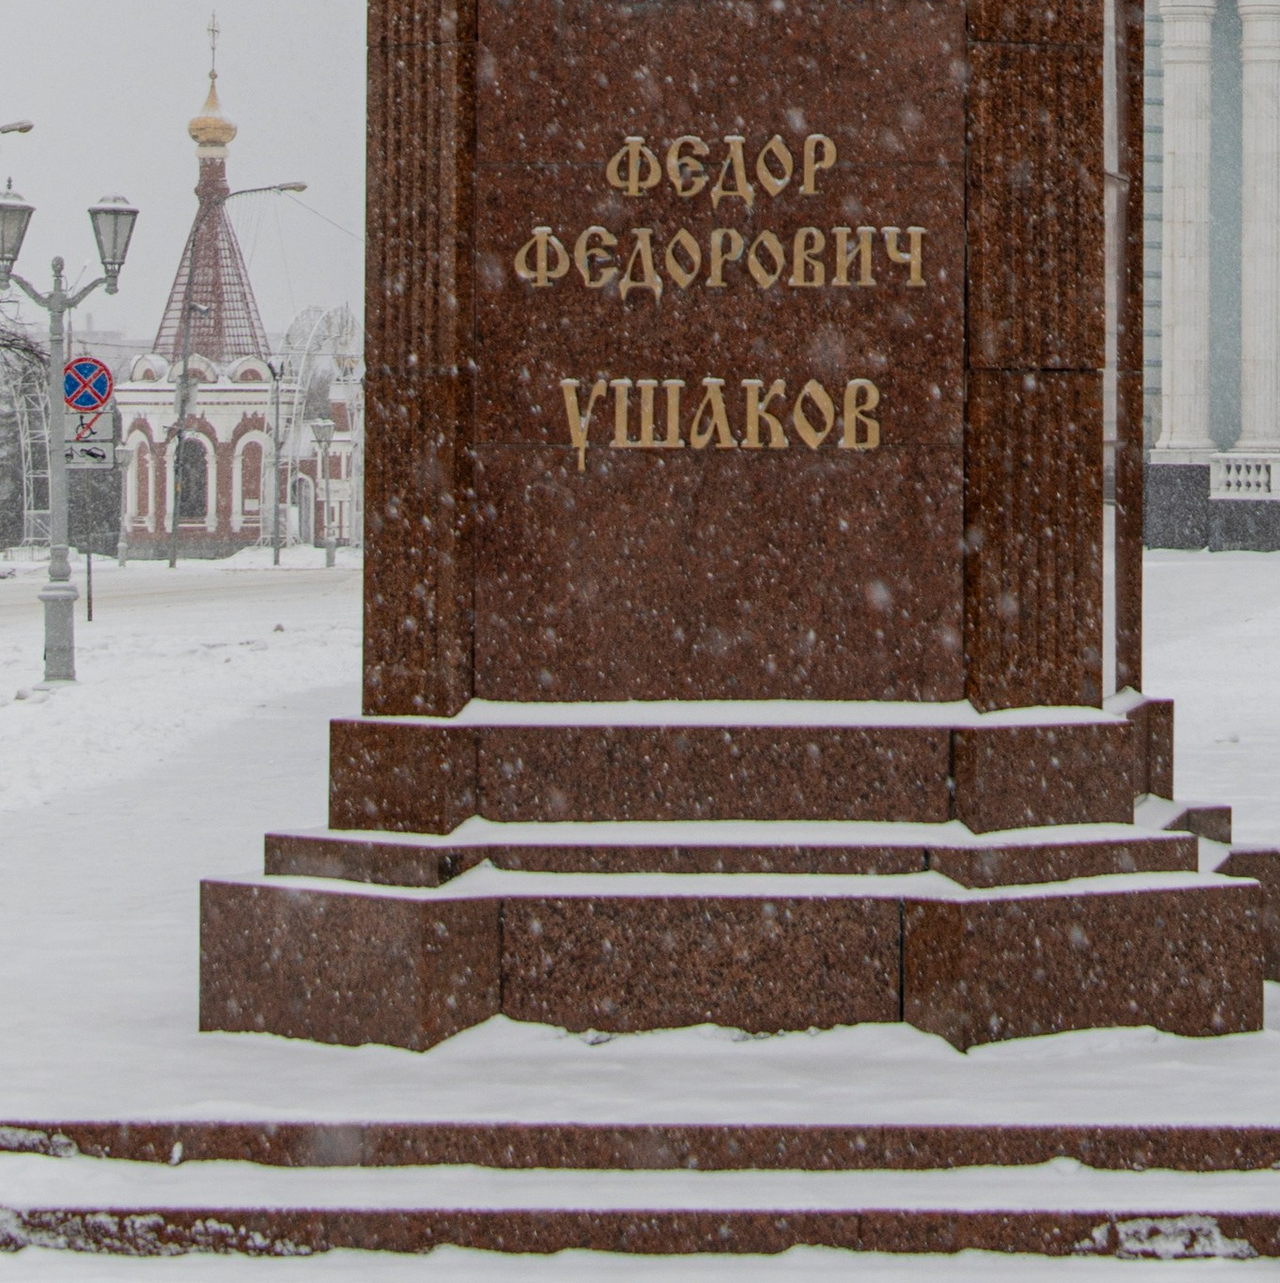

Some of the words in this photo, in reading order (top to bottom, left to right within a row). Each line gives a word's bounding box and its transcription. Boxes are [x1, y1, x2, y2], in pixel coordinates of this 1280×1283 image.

[605, 134, 837, 210] ФЕДОР
[513, 226, 927, 303] ФЕДОРОВИЧ
[559, 378, 881, 472] УШАКОВ
